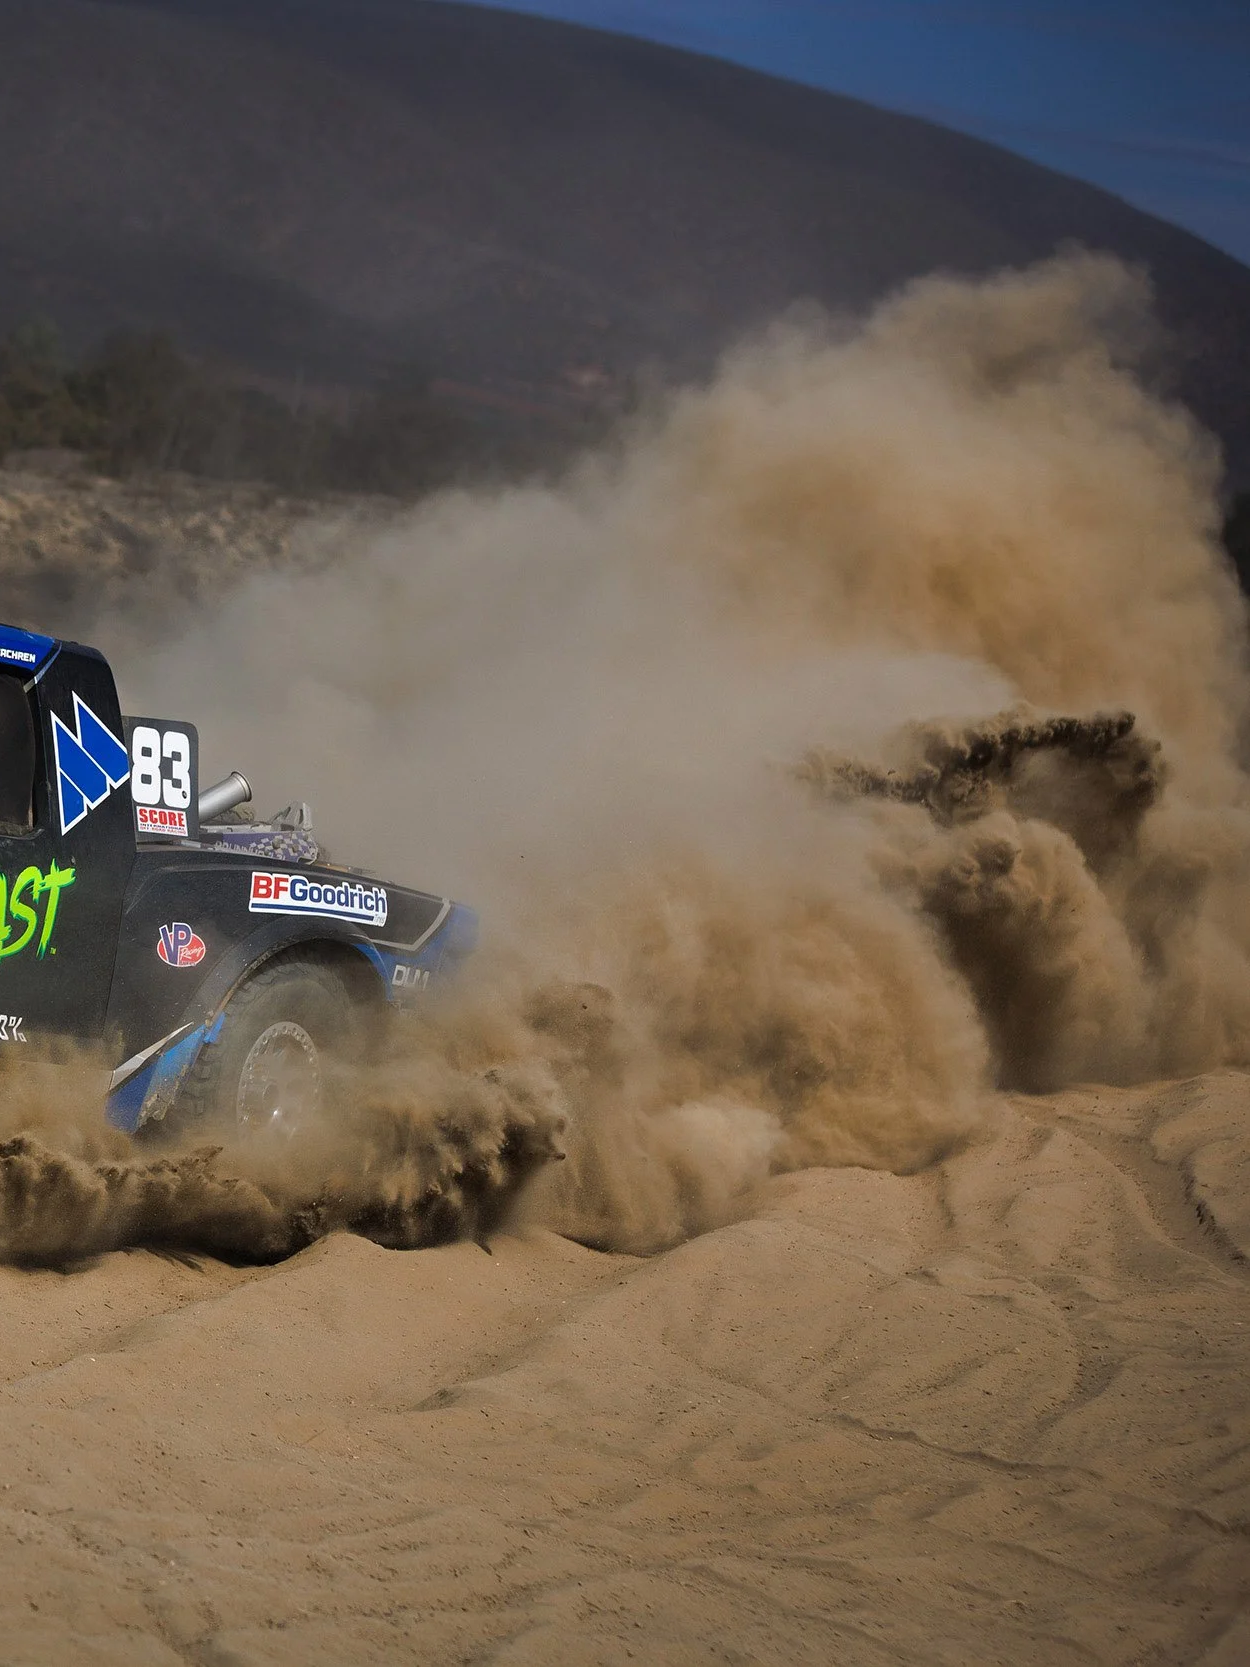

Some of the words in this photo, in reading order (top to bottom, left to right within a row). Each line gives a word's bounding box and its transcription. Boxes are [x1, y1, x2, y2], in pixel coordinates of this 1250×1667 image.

[131, 726, 191, 809] 83
[138, 808, 186, 827] SCORE
[252, 874, 387, 914] BFGoodrich
[159, 922, 193, 966] VP
